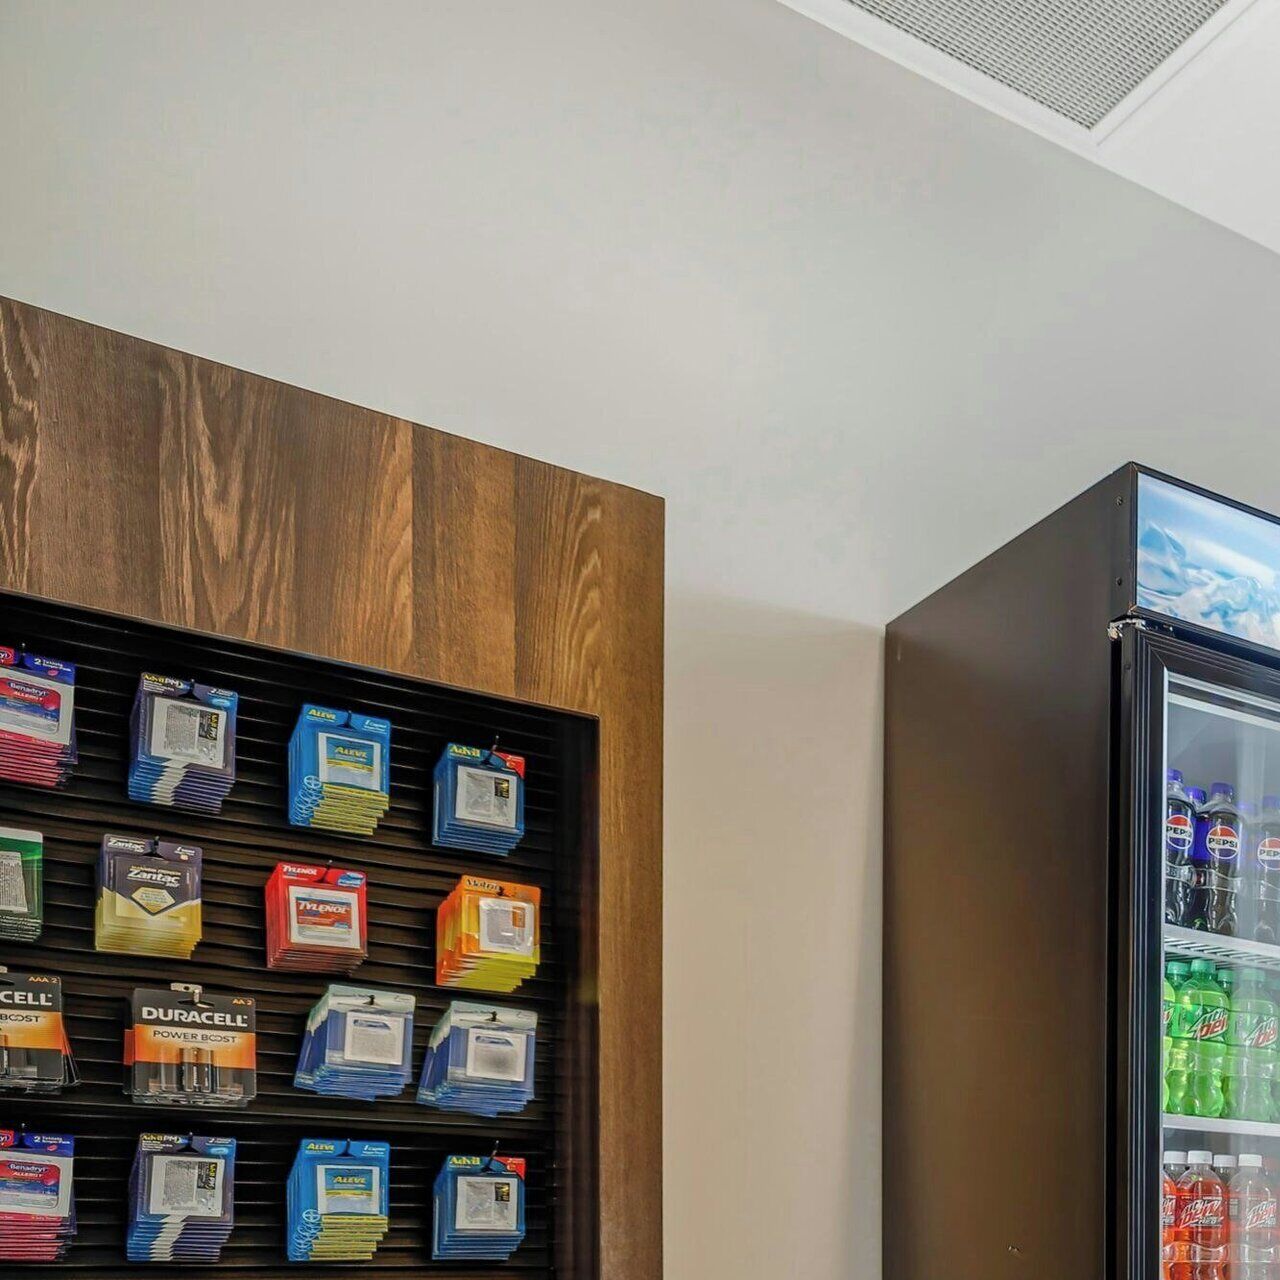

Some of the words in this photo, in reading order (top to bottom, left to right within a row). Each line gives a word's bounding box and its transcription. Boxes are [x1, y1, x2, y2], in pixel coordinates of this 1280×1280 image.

[108, 839, 145, 850] Zantac
[1209, 838, 1237, 848] PEPSI
[127, 869, 180, 883] Zantac
[283, 865, 317, 875] TYLENOL
[299, 901, 349, 914] TYLENOL
[0, 991, 52, 1006] CELL
[142, 1007, 248, 1027] DURACELL
[153, 1030, 197, 1040] POWER
[201, 1033, 237, 1043] BOOST
